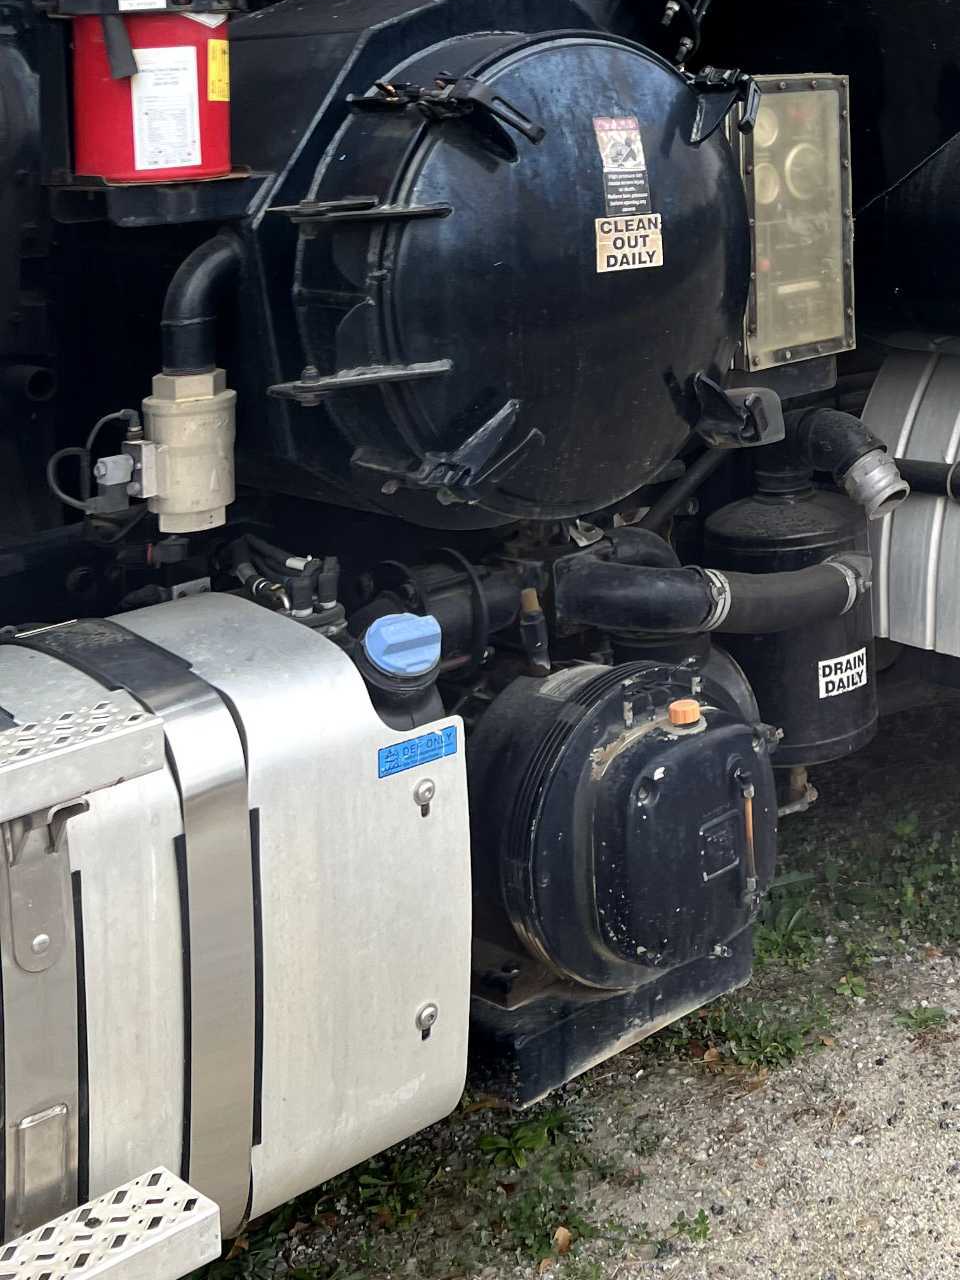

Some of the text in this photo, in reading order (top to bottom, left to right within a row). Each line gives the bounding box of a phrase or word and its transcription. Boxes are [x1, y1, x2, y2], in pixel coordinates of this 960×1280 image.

[600, 216, 659, 235] CLEAN
[612, 234, 650, 251] OUT
[606, 250, 657, 268] DAILY
[822, 652, 865, 678] DRAIN
[825, 669, 864, 694] DAILY
[426, 733, 452, 748] ONLY
